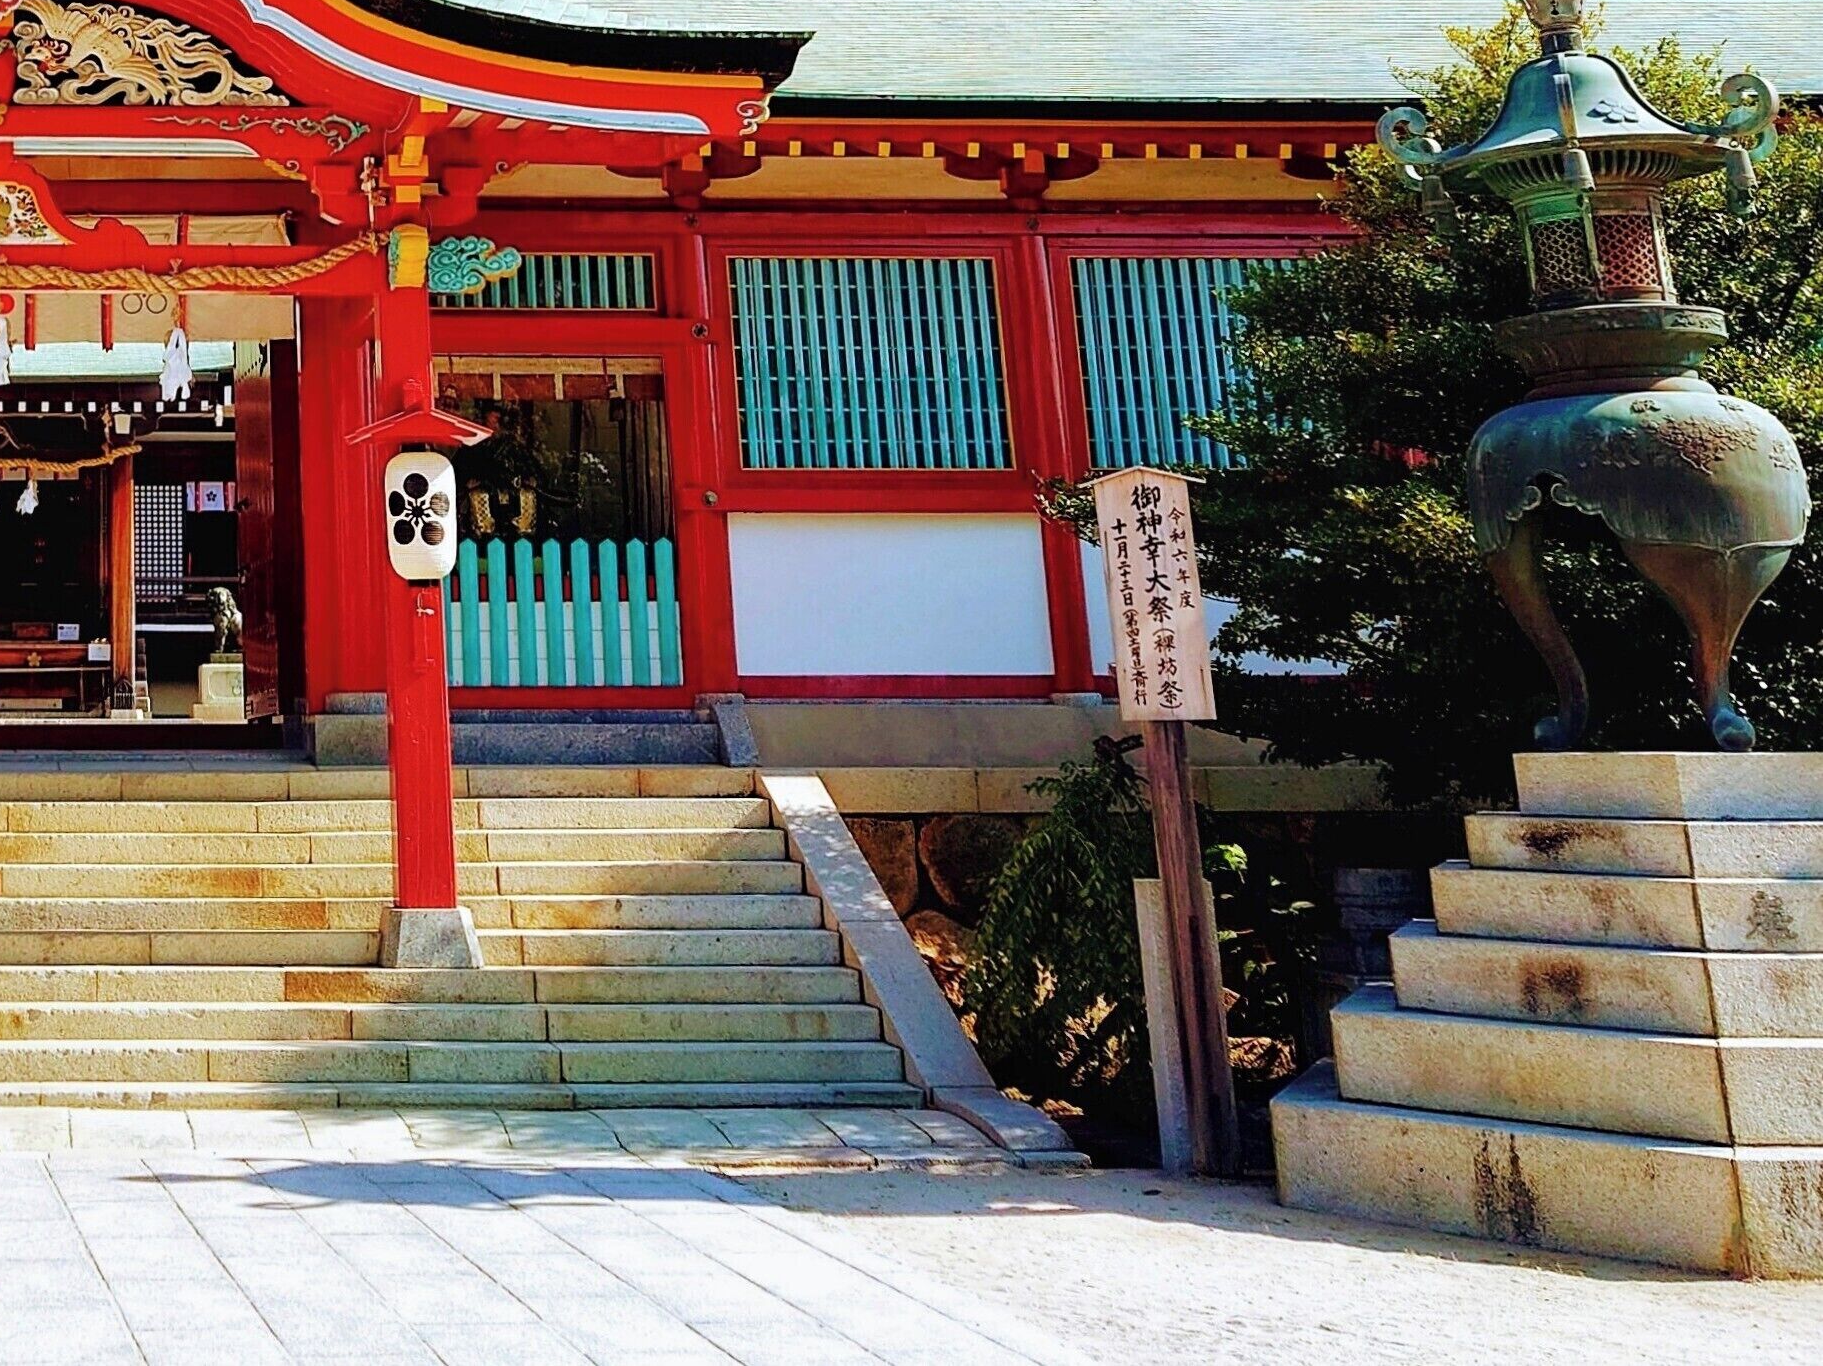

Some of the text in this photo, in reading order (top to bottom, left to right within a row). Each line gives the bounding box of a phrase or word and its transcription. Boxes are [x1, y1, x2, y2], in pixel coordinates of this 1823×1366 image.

[1168, 506, 1196, 609] 令和六年度
